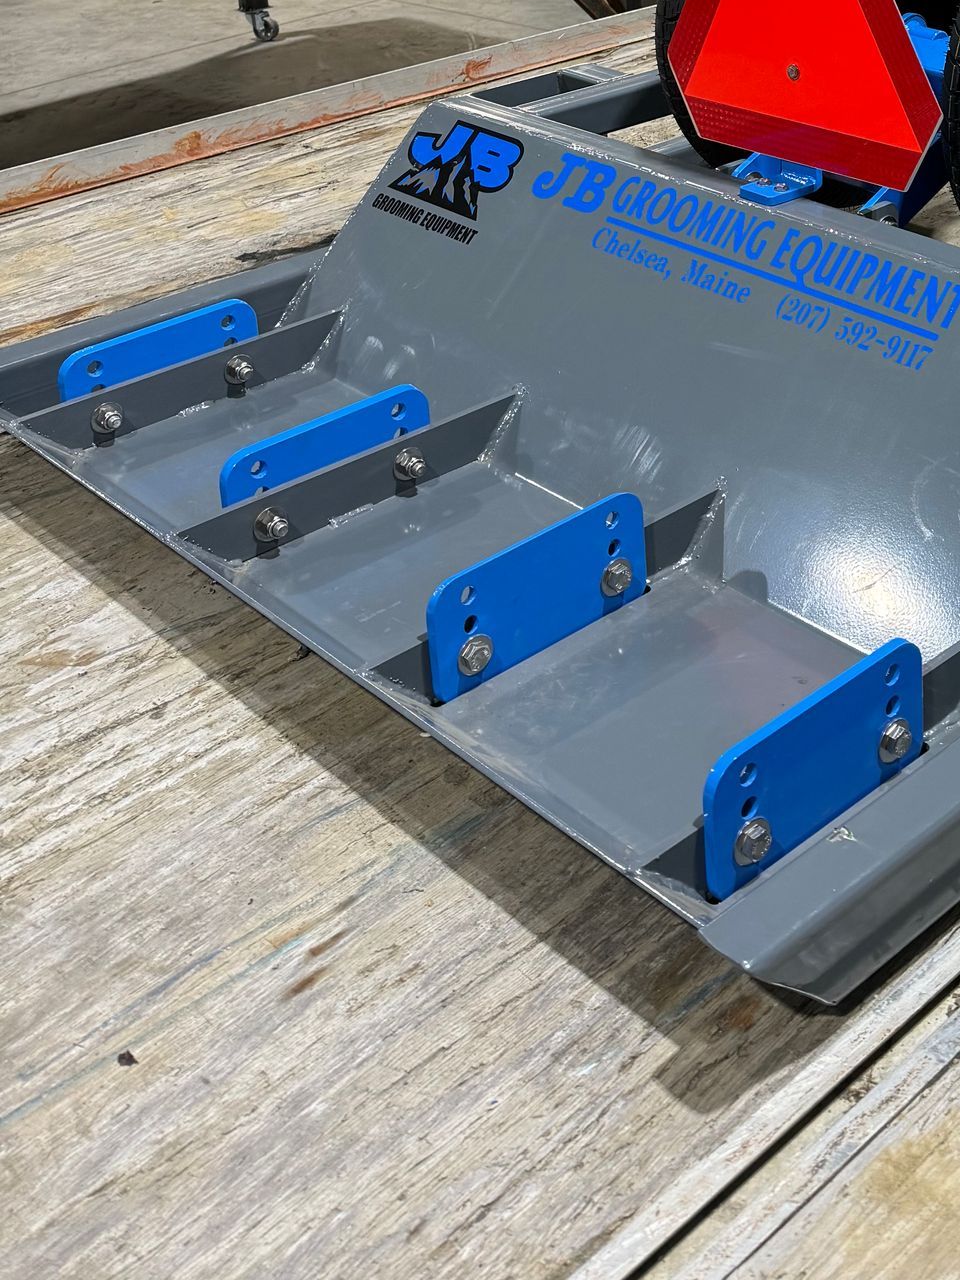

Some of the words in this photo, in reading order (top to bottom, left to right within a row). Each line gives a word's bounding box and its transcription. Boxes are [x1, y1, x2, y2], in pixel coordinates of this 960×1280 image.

[407, 119, 525, 193] JB
[372, 193, 424, 225] GROOMING
[420, 214, 479, 245] EQUIPMENT
[531, 152, 618, 213] JB
[612, 176, 777, 261] GROOMING
[591, 226, 671, 280] Chelsea,
[680, 259, 751, 304] Maine
[775, 293, 831, 333] (207)
[834, 317, 934, 371] 592-9117
